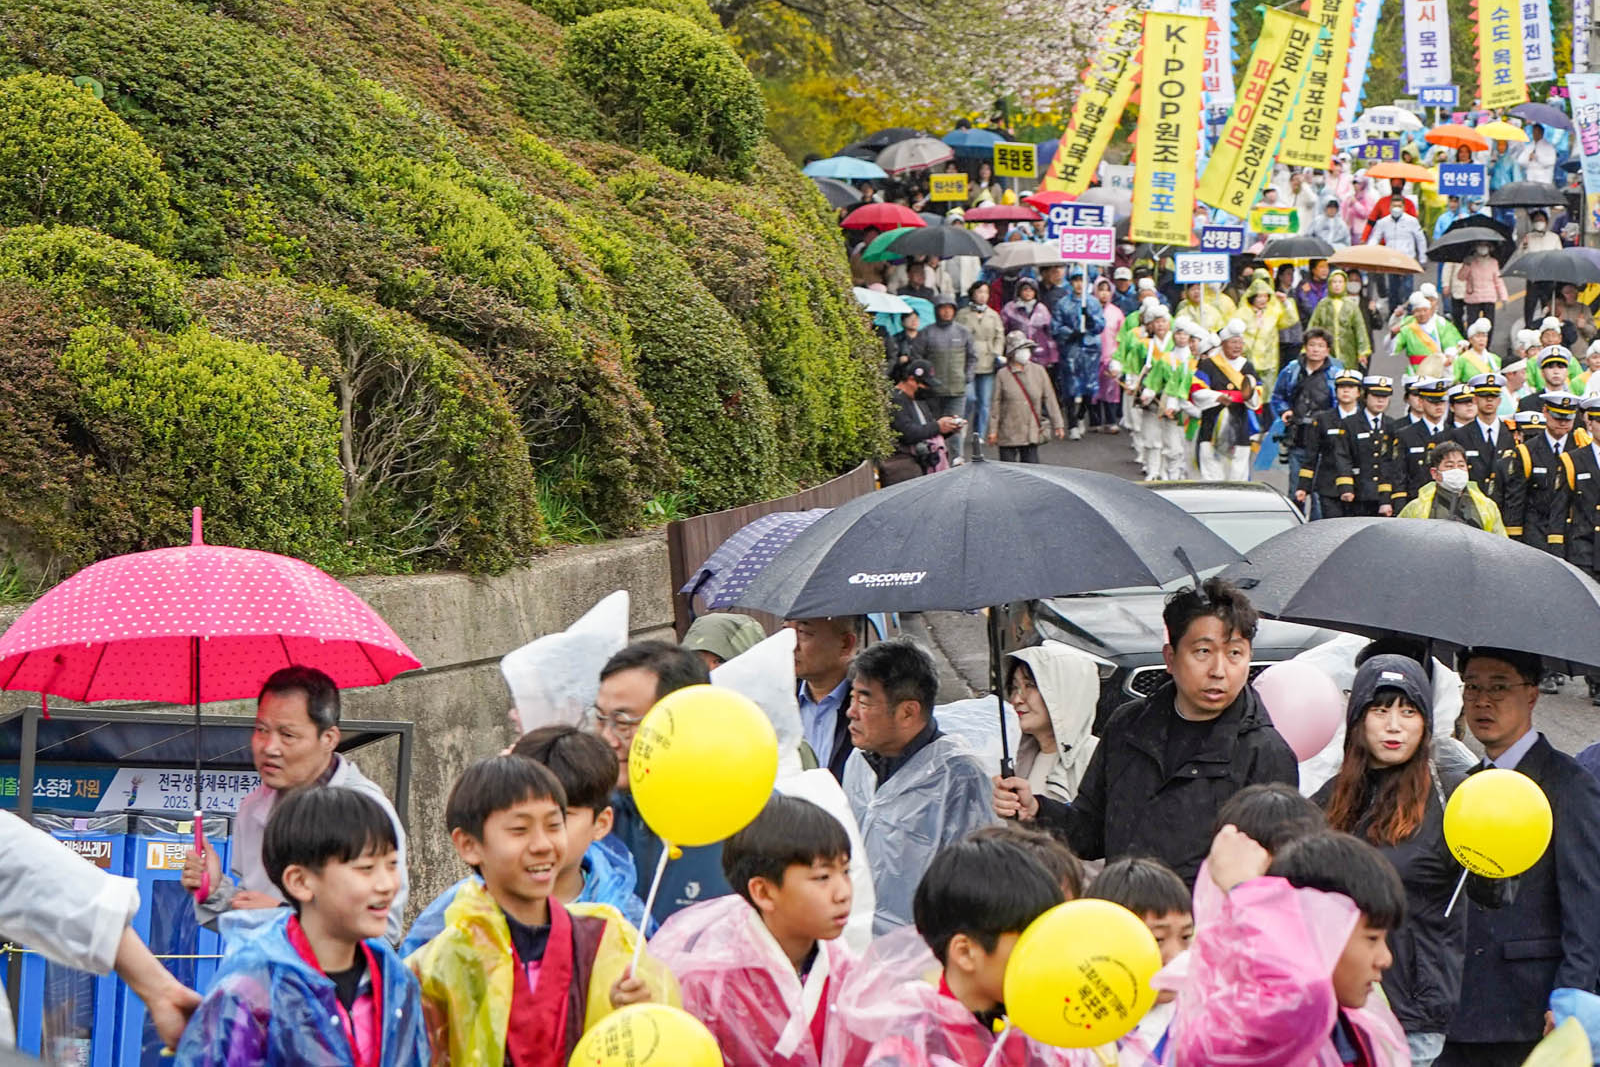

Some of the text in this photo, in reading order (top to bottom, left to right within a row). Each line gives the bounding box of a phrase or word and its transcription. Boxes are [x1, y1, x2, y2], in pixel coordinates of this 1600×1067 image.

[1490, 7, 1511, 42] 수도
[1419, 31, 1439, 70] 목포
[1492, 49, 1513, 86] 목포
[1231, 28, 1311, 206] 만호 수군 출정식 &
[1300, 71, 1328, 142] 목포신안
[997, 148, 1034, 172] 목원동
[1149, 171, 1176, 213] 목포
[1442, 172, 1482, 187] 연산동
[1202, 230, 1241, 250] 산정동
[856, 571, 927, 584] Discovery
[32, 778, 73, 798] 소중한
[74, 779, 100, 798] 자원
[163, 795, 192, 810] 2025.
